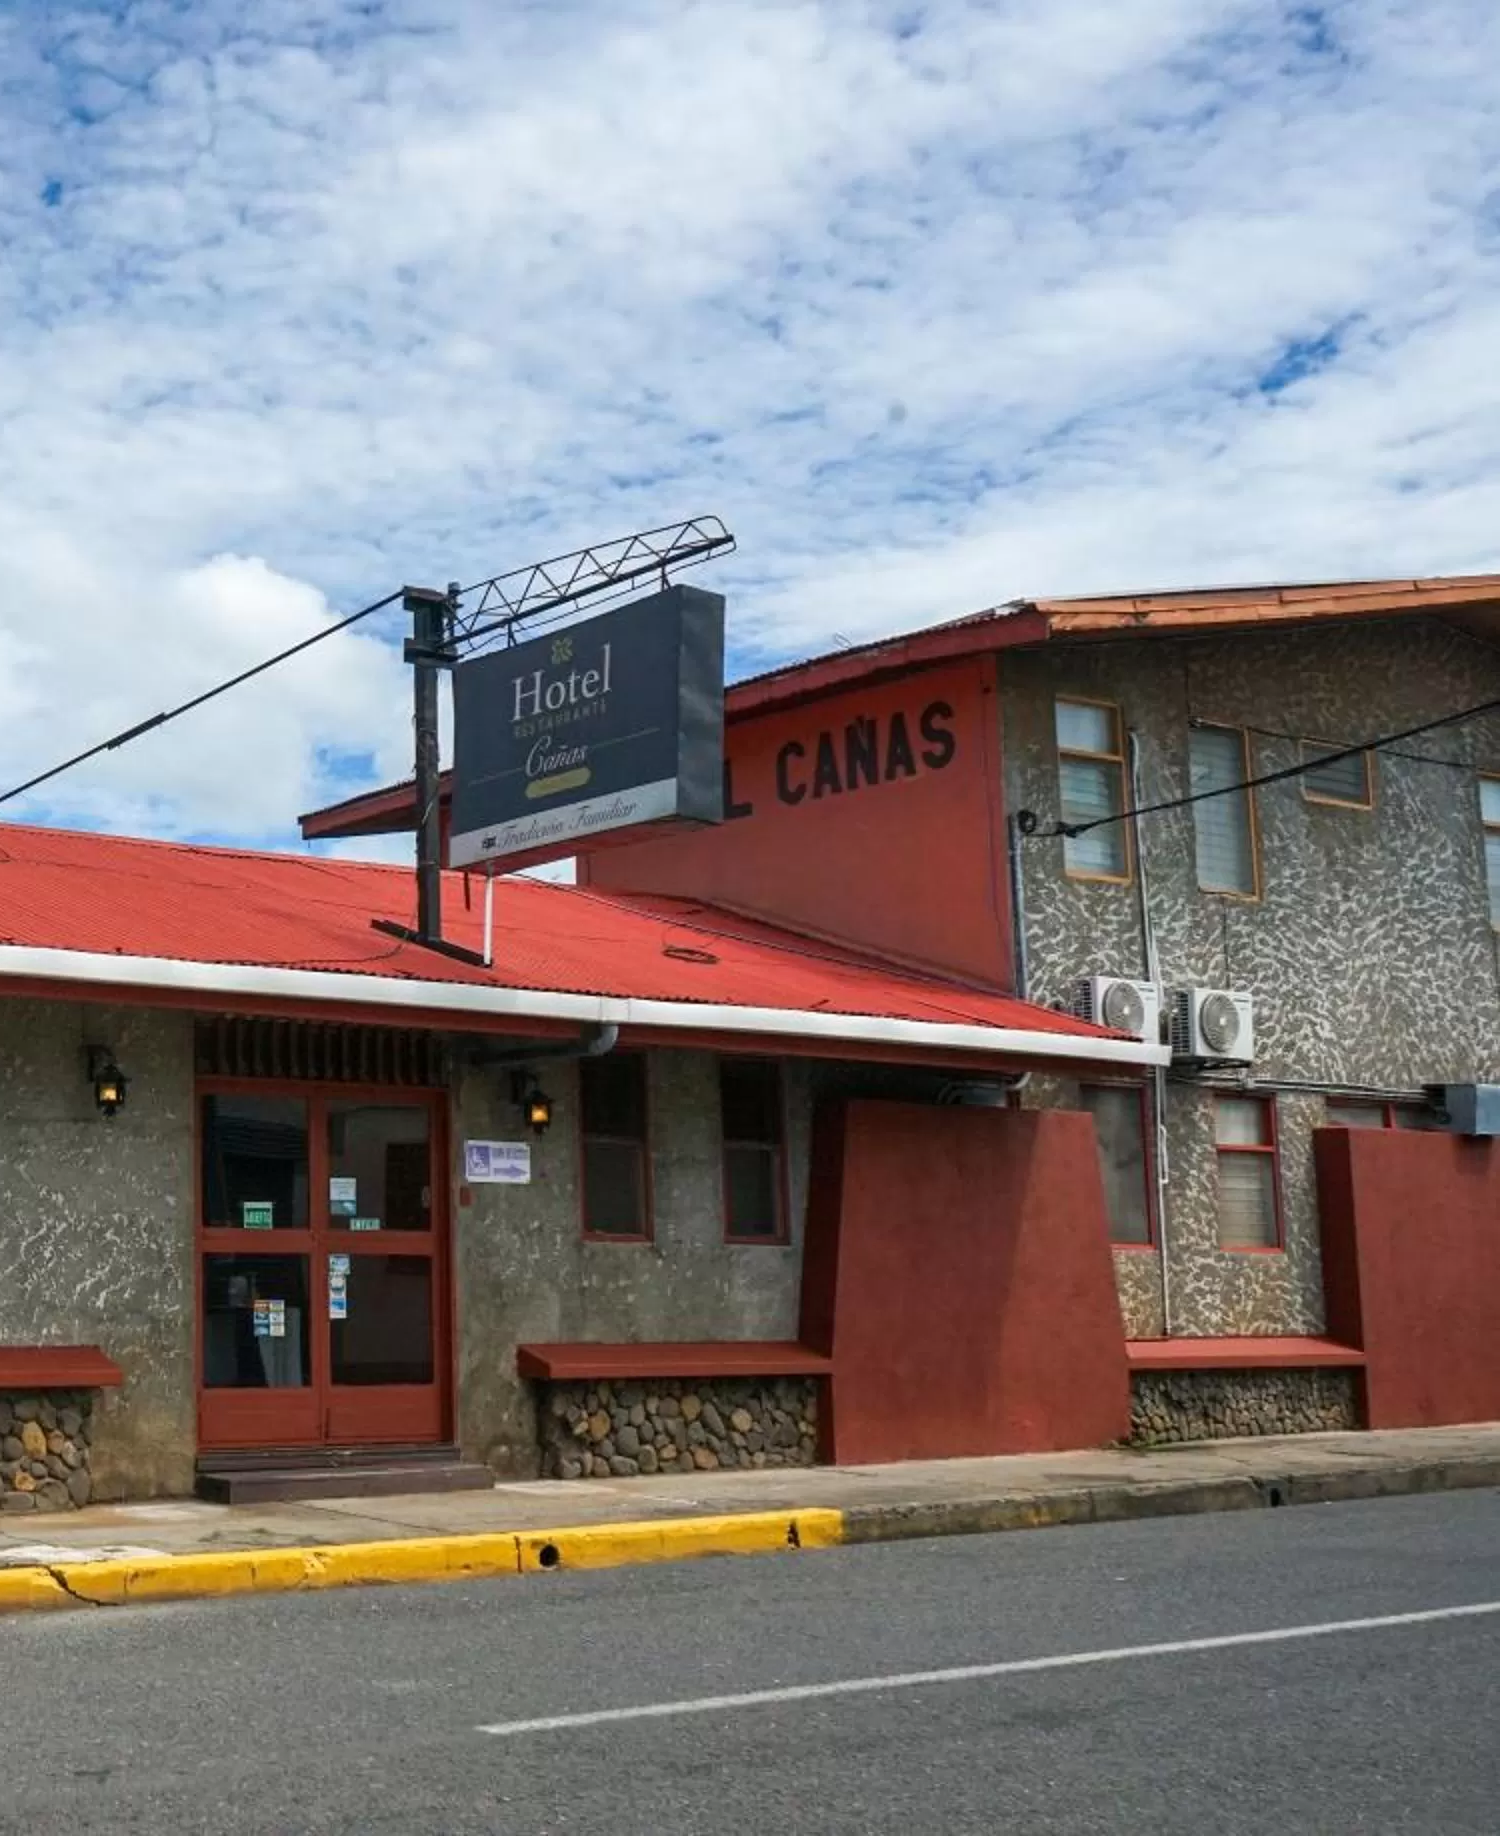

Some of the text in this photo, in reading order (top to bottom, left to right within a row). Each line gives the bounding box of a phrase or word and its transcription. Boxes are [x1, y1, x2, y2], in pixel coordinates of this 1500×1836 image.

[509, 640, 612, 722] Hotel
[525, 735, 589, 777] Cañas
[568, 798, 638, 831] Familiar
